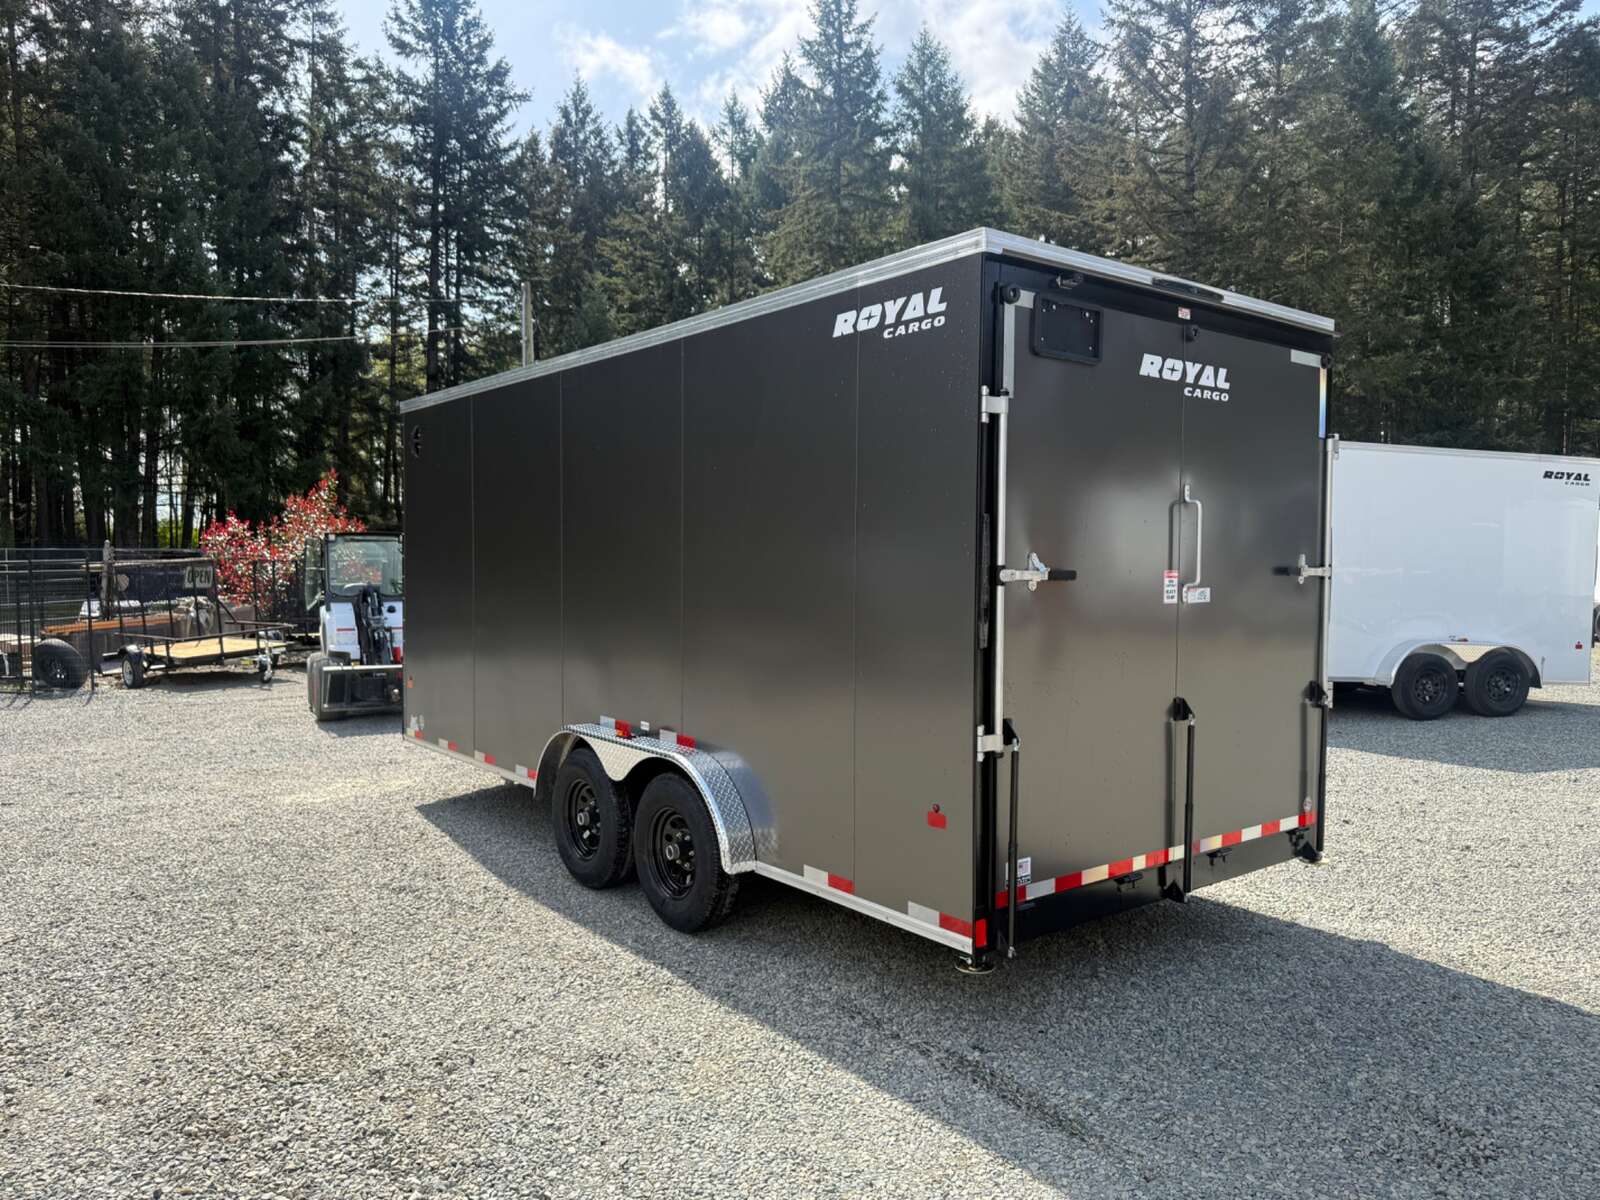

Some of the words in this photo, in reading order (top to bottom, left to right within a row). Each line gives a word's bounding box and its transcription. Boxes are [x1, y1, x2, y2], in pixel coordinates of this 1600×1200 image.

[832, 287, 947, 338] ROYAL
[883, 315, 946, 338] CARGO
[1139, 353, 1231, 389] ROYAL
[1184, 387, 1230, 402] CARGO
[1543, 470, 1591, 481] ROYAL
[187, 569, 211, 584] OPEN
